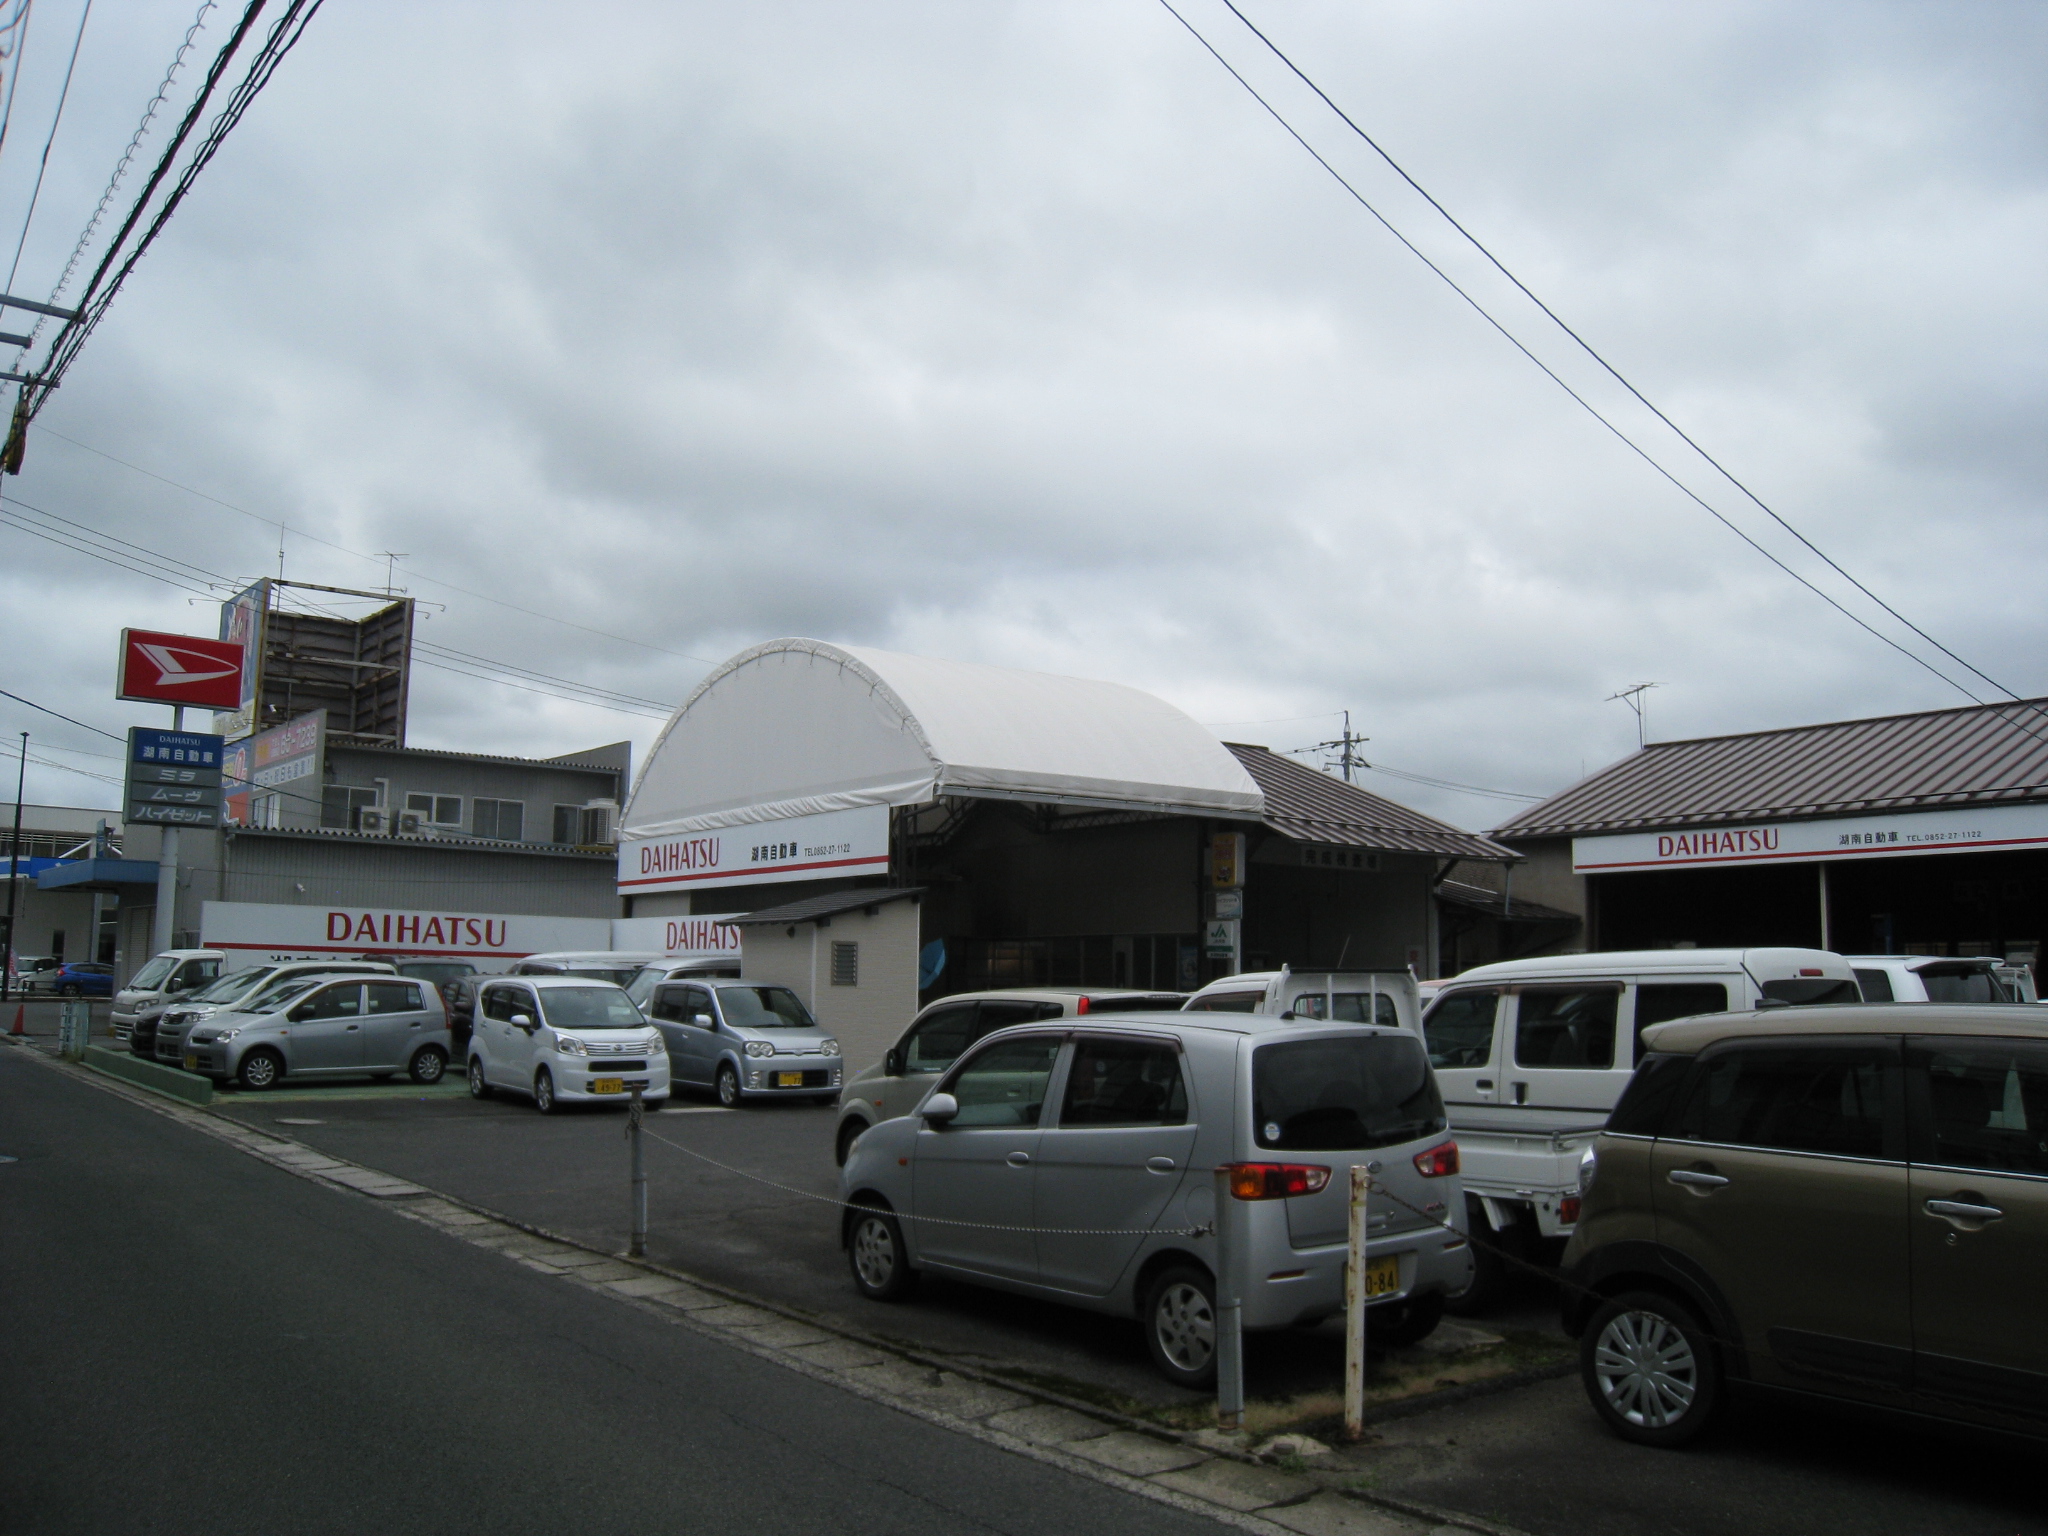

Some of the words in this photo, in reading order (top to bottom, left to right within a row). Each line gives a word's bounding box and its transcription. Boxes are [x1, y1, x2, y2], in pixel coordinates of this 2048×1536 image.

[159, 735, 200, 746] DAIHATSU
[143, 746, 213, 763] 湖南自動車
[159, 769, 196, 782] ミラ
[151, 788, 202, 802] ムーヴ
[135, 806, 212, 822] ハイゼット
[1658, 828, 1779, 857] DAIHATSU
[1839, 831, 1899, 846] 湖南自動車
[641, 837, 720, 874] DAIHATSU
[751, 842, 797, 862] 湖南自動車
[327, 912, 506, 947] DAIHATSU
[666, 920, 743, 950] DAIHATS
